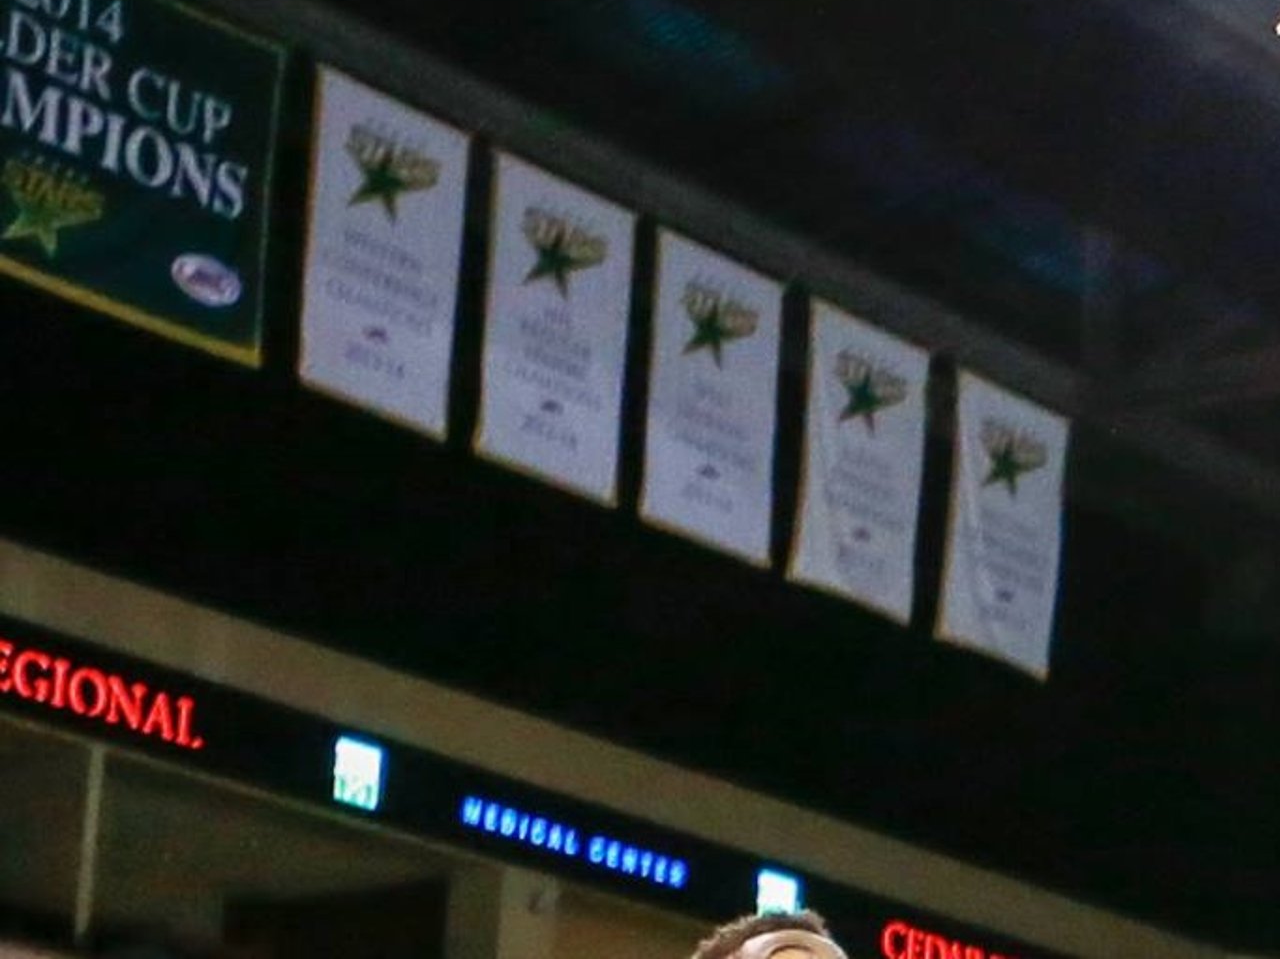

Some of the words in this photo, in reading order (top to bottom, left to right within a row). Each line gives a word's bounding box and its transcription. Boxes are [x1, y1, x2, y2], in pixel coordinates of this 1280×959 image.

[0, 66, 249, 221] MPIONS
[127, 66, 232, 144] CUP
[460, 794, 580, 857] MEDICAL
[587, 834, 691, 890] CENTER
